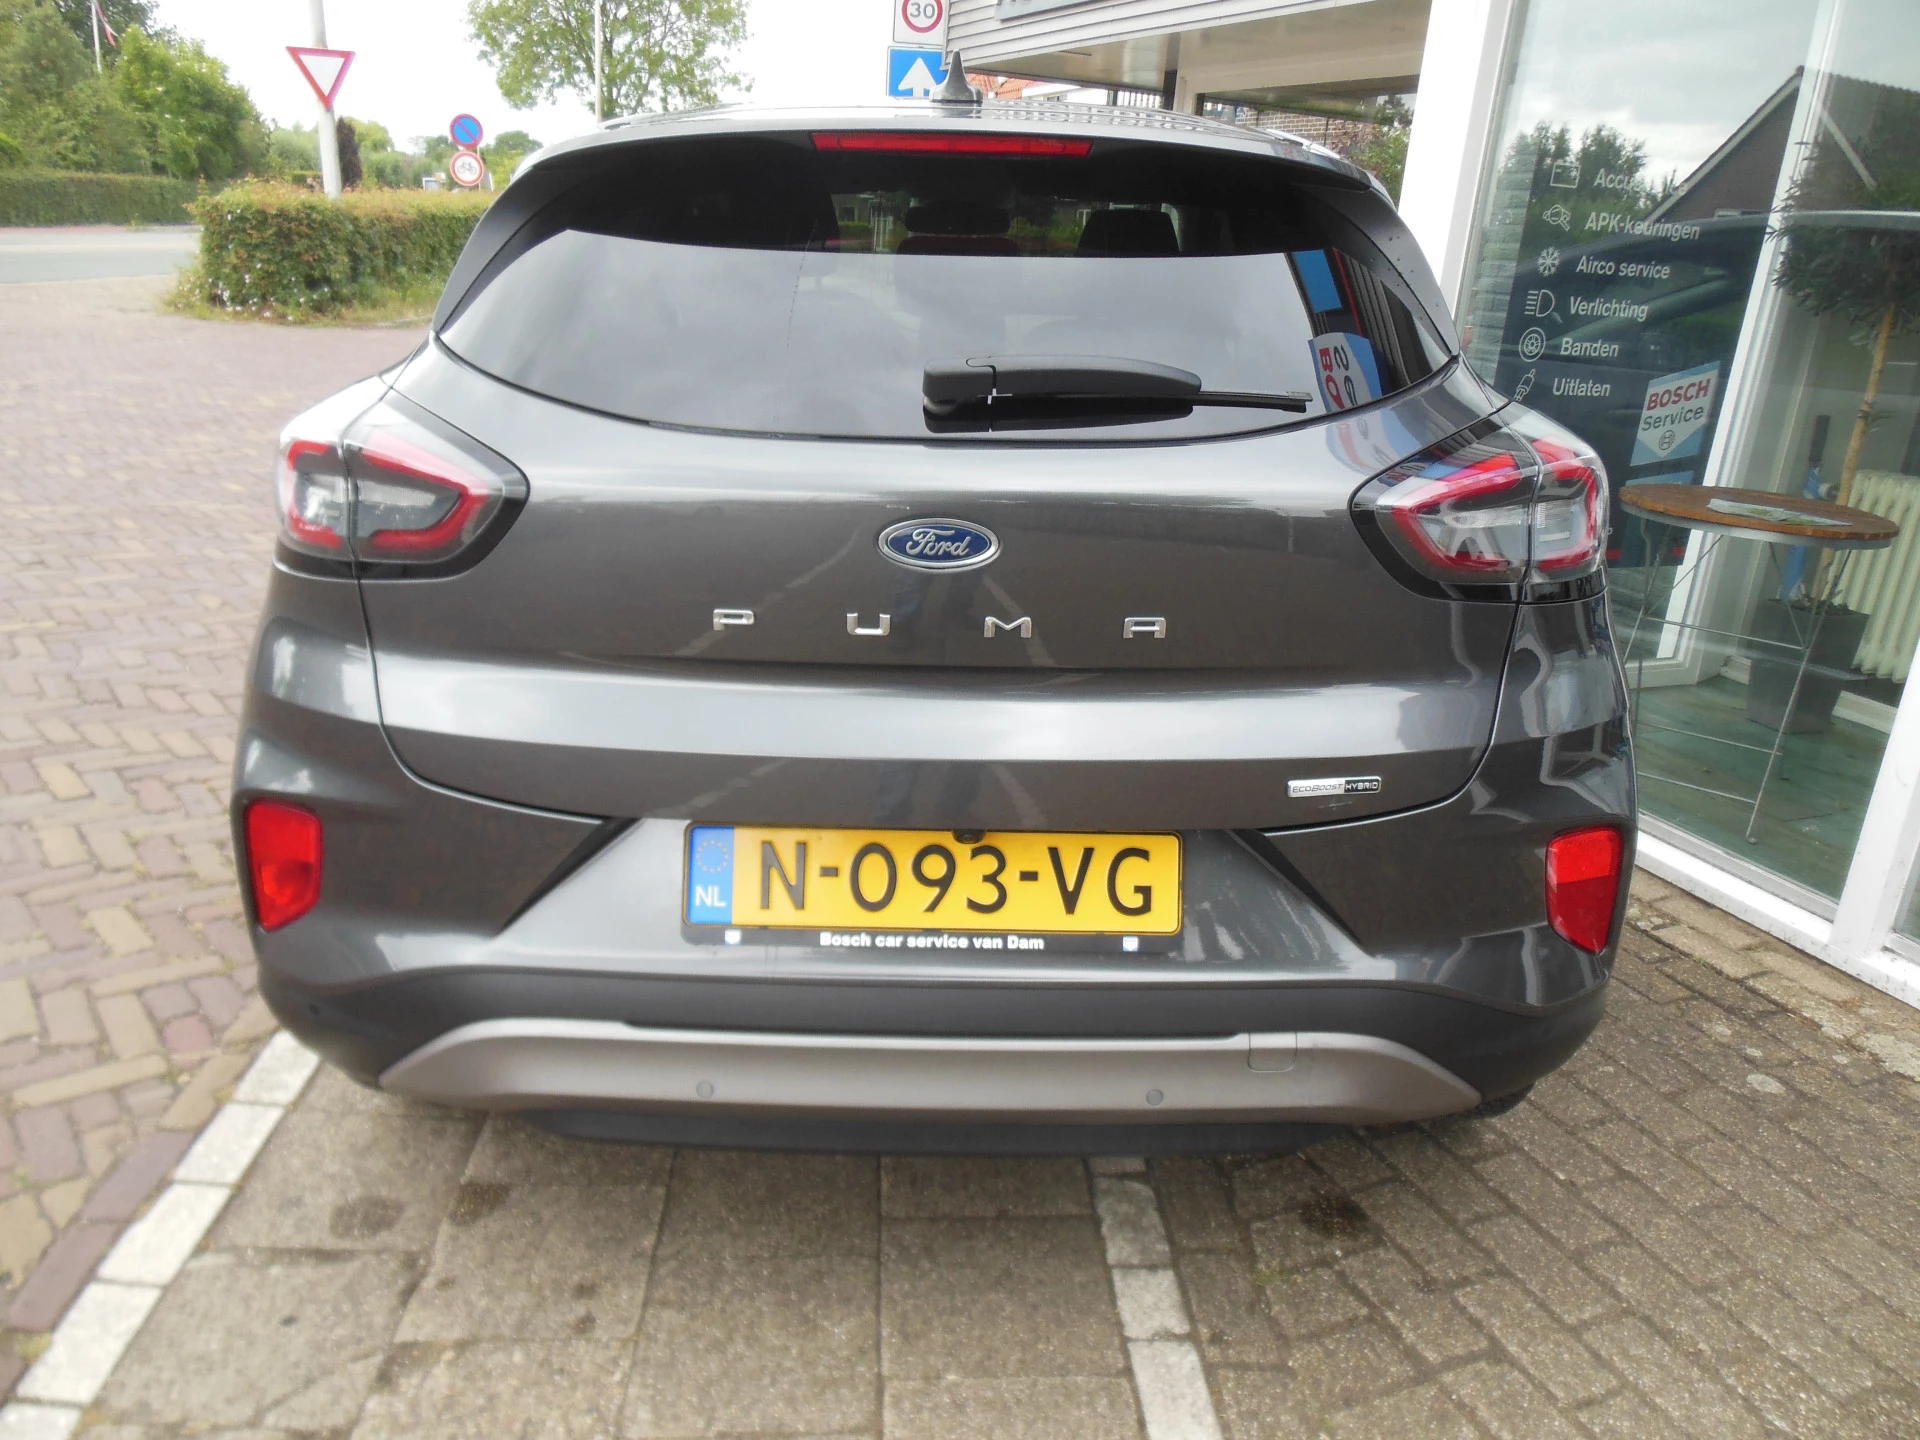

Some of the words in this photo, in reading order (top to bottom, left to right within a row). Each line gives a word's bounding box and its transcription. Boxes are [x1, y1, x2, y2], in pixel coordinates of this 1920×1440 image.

[909, 2, 936, 19] 30
[1585, 211, 1700, 242] APK-keuringen
[1576, 255, 1615, 275] Airco
[1618, 261, 1671, 279] service
[1570, 296, 1649, 322] Verlichting
[1560, 337, 1619, 358] Banden
[1552, 378, 1611, 397] Uitlaten
[1646, 378, 1711, 411] BOSCH
[1641, 406, 1704, 432] Service
[905, 528, 972, 556] Ford
[713, 608, 1166, 639] PUMA
[1345, 781, 1379, 790] HYBRID
[760, 839, 1153, 917] N-093-VG
[695, 884, 727, 907] NL
[819, 931, 871, 946] Bosch
[875, 934, 904, 947] car
[906, 933, 969, 949] service
[972, 936, 1003, 949] van
[1007, 935, 1045, 950] Dam
